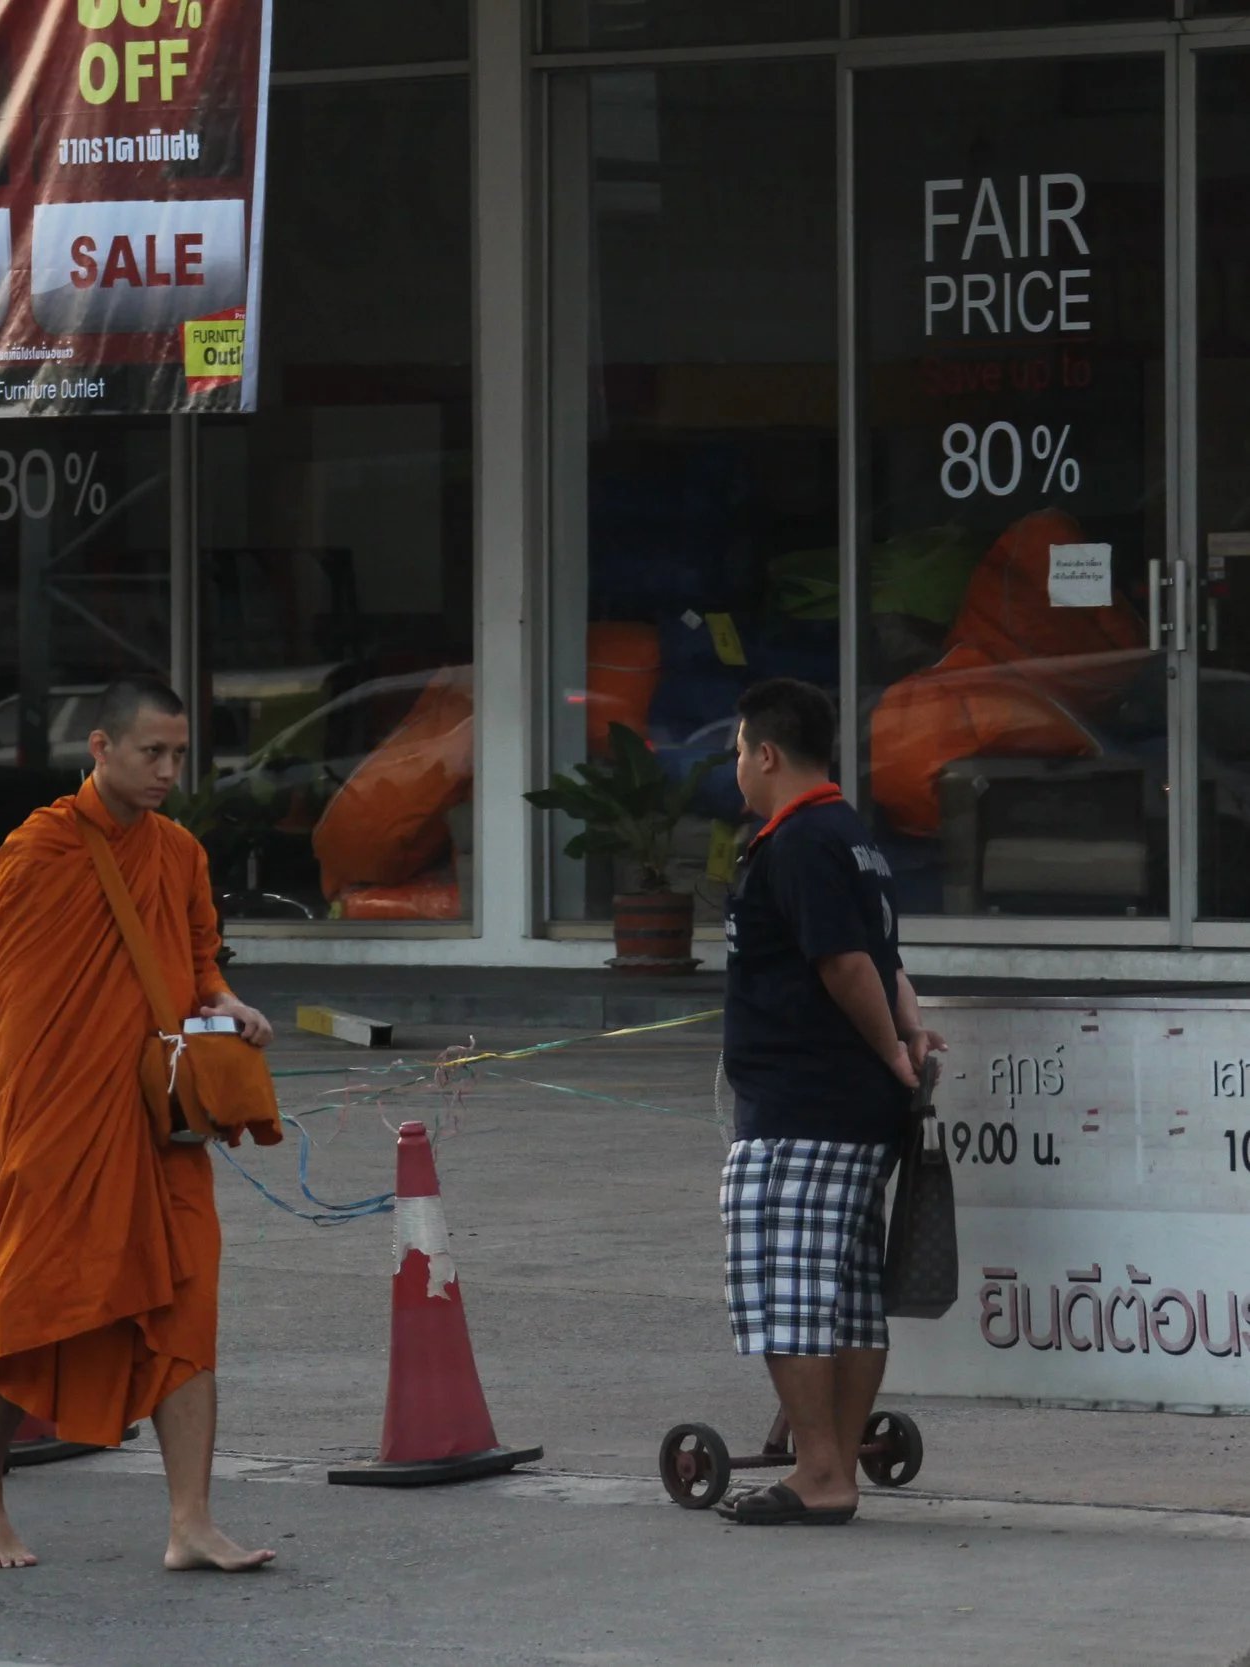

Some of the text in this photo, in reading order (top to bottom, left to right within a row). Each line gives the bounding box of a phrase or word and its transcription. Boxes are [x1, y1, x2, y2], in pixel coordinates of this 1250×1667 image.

[78, 39, 190, 106] OFF
[58, 129, 200, 165] จากราคาพิเศษ
[924, 173, 1091, 263] FAIR
[69, 233, 204, 290] SALE
[924, 269, 1091, 337] PRICE
[61, 376, 105, 400] Outlet
[204, 346, 244, 367] Outl
[922, 350, 1092, 398] Save up to
[940, 421, 1080, 499] 80%
[989, 1043, 1064, 1109] ศุกร์
[979, 1262, 1250, 1358] ยินดีต้อน
